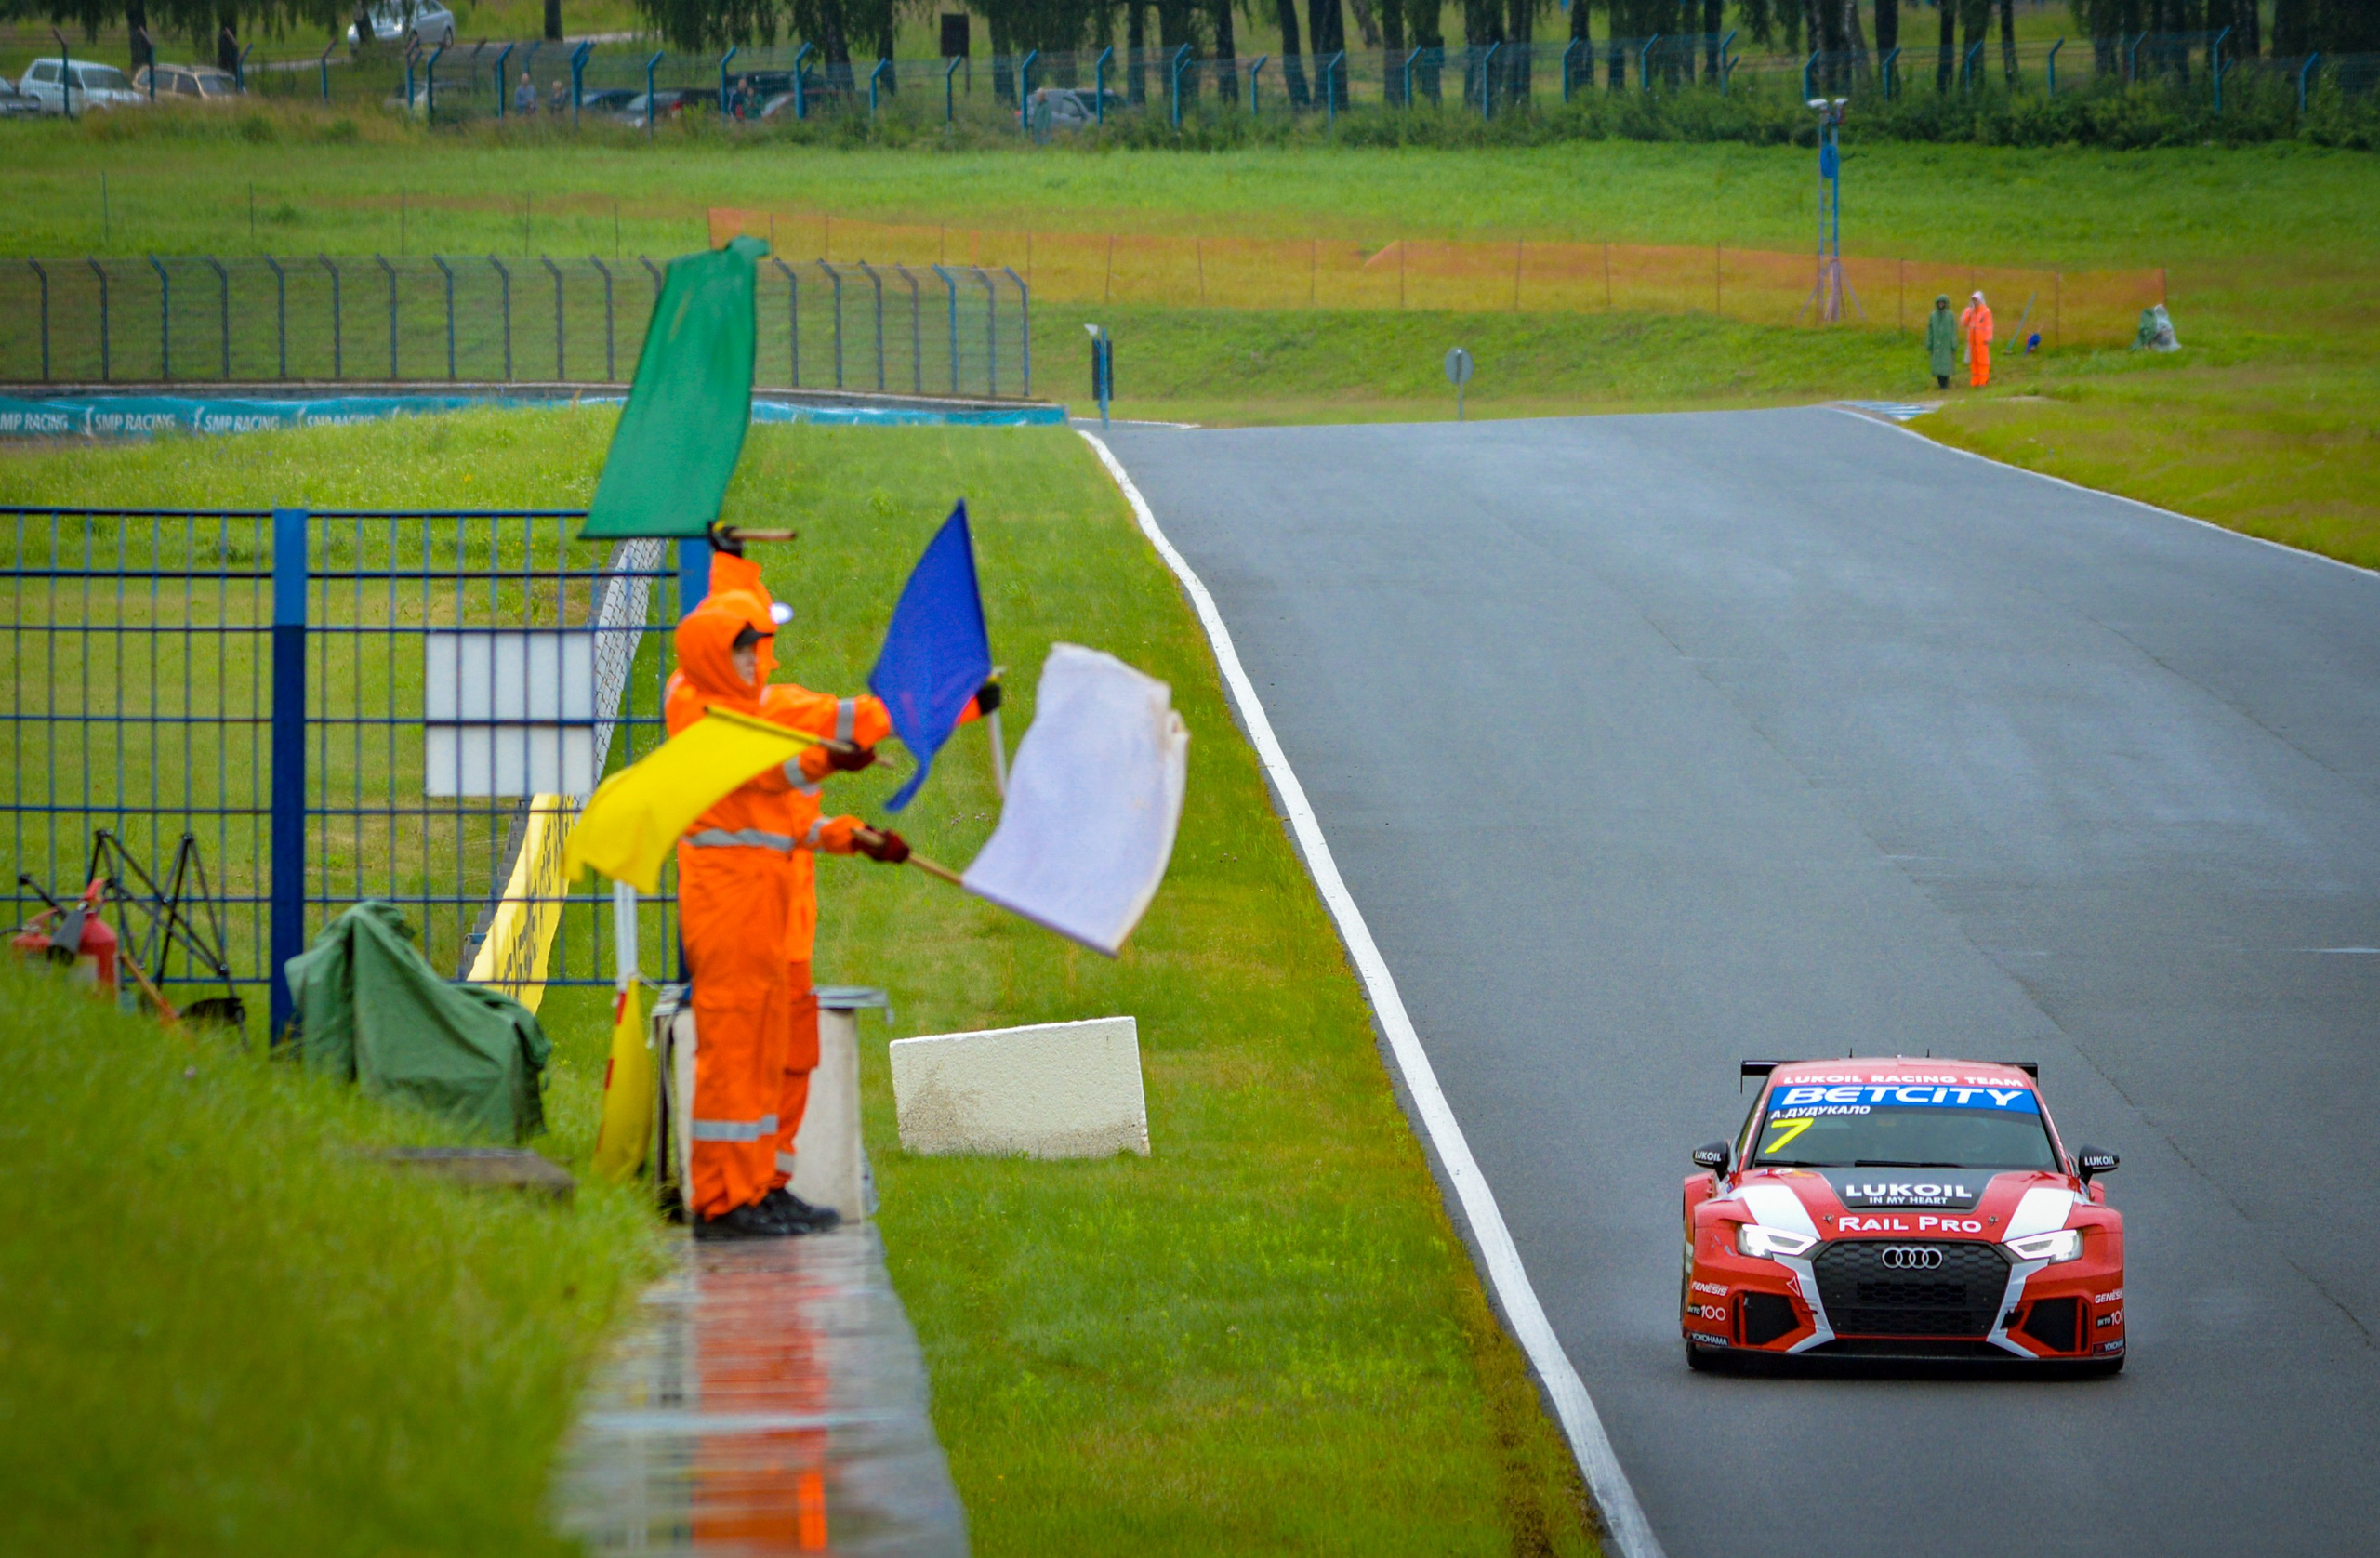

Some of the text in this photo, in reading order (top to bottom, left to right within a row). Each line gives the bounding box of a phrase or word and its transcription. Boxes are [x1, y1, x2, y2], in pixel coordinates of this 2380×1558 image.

[24, 413, 69, 431] RACING
[95, 414, 176, 431] SMP RACING
[204, 415, 280, 432] SMP RACING
[1783, 1076, 2024, 1087] LUKOIL RACING TEAM
[1765, 1118, 1814, 1154] 7
[1695, 1150, 1722, 1162] LUKOIL
[2084, 1155, 2115, 1166] LUKOIL
[1846, 1183, 1972, 1198] LUKOIL
[1886, 1196, 1907, 1205] MY
[1910, 1196, 1948, 1205] HEART
[1700, 1304, 1726, 1321] 100
[1692, 1333, 1727, 1345] YOKOHAMA
